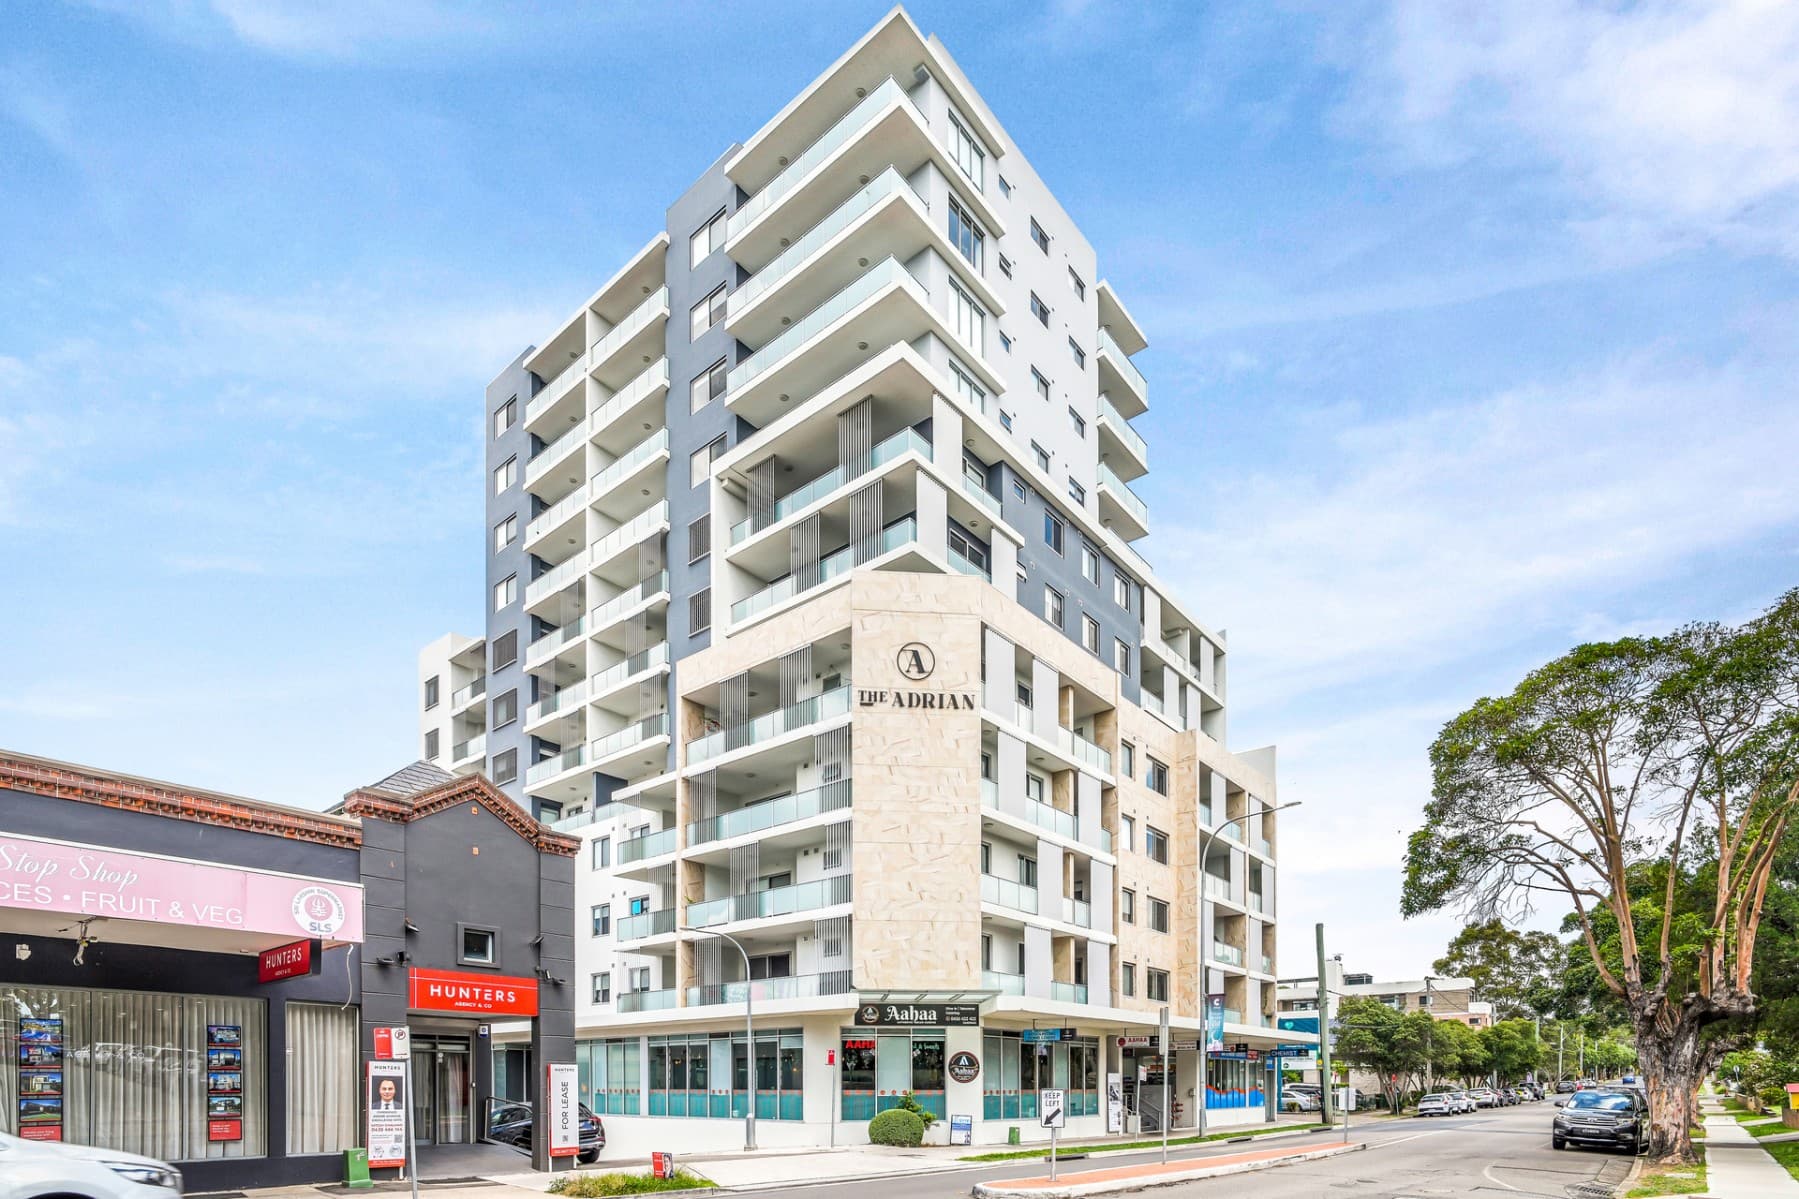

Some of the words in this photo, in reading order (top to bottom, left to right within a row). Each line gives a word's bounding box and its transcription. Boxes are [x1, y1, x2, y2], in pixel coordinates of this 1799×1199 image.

[858, 690, 888, 703] THE
[892, 691, 975, 711] ADRIAN
[0, 844, 58, 882] Stop
[69, 855, 138, 892] Shop
[81, 891, 160, 914] FRUIT
[168, 901, 185, 919] &
[192, 903, 243, 924] VEG
[309, 921, 332, 933] SLS
[265, 947, 302, 969] HUNTERS
[429, 984, 516, 1003] HUNTERS
[884, 1005, 938, 1022] Aahaa
[1271, 1050, 1297, 1058] CHEMIST
[561, 1081, 569, 1109] LEASE
[561, 1111, 569, 1130] FOR
